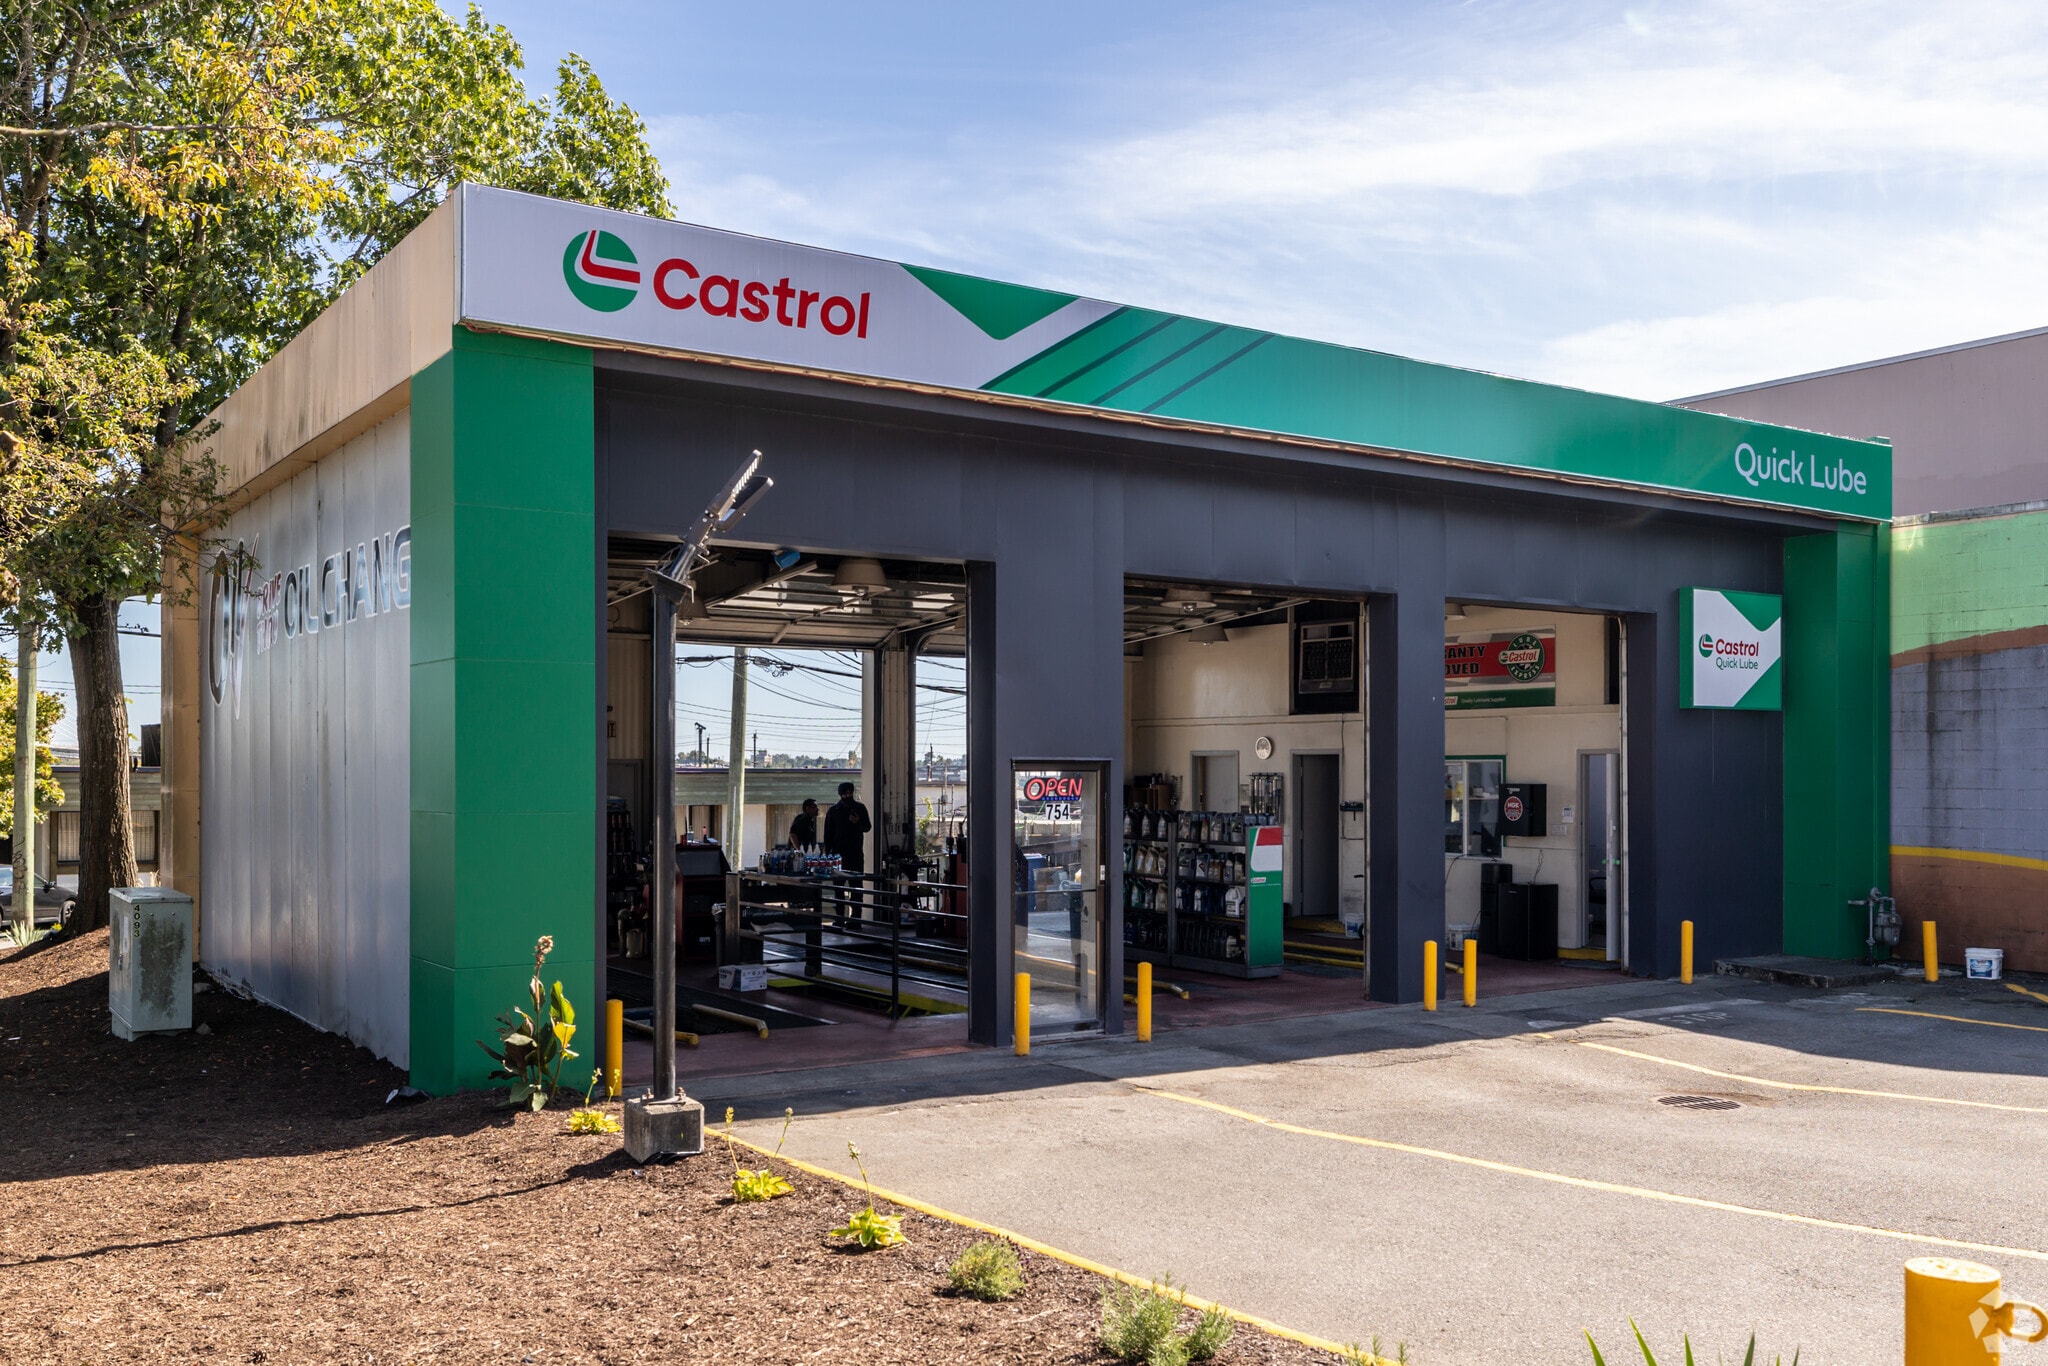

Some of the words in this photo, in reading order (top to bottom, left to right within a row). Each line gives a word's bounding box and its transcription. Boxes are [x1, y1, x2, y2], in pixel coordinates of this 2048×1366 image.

[653, 258, 870, 339] Castrol
[1735, 443, 1804, 487] Quick
[1811, 455, 1867, 495] Lube
[284, 563, 319, 640] OIL
[1445, 645, 1485, 658] ANTY
[1508, 650, 1537, 662] Castrol
[1715, 638, 1760, 657] Castrol
[1715, 656, 1739, 671] Quick
[1739, 658, 1759, 670] Lube
[1026, 778, 1083, 800] OPEN
[1046, 804, 1069, 820] 754
[133, 904, 141, 938] 4093
